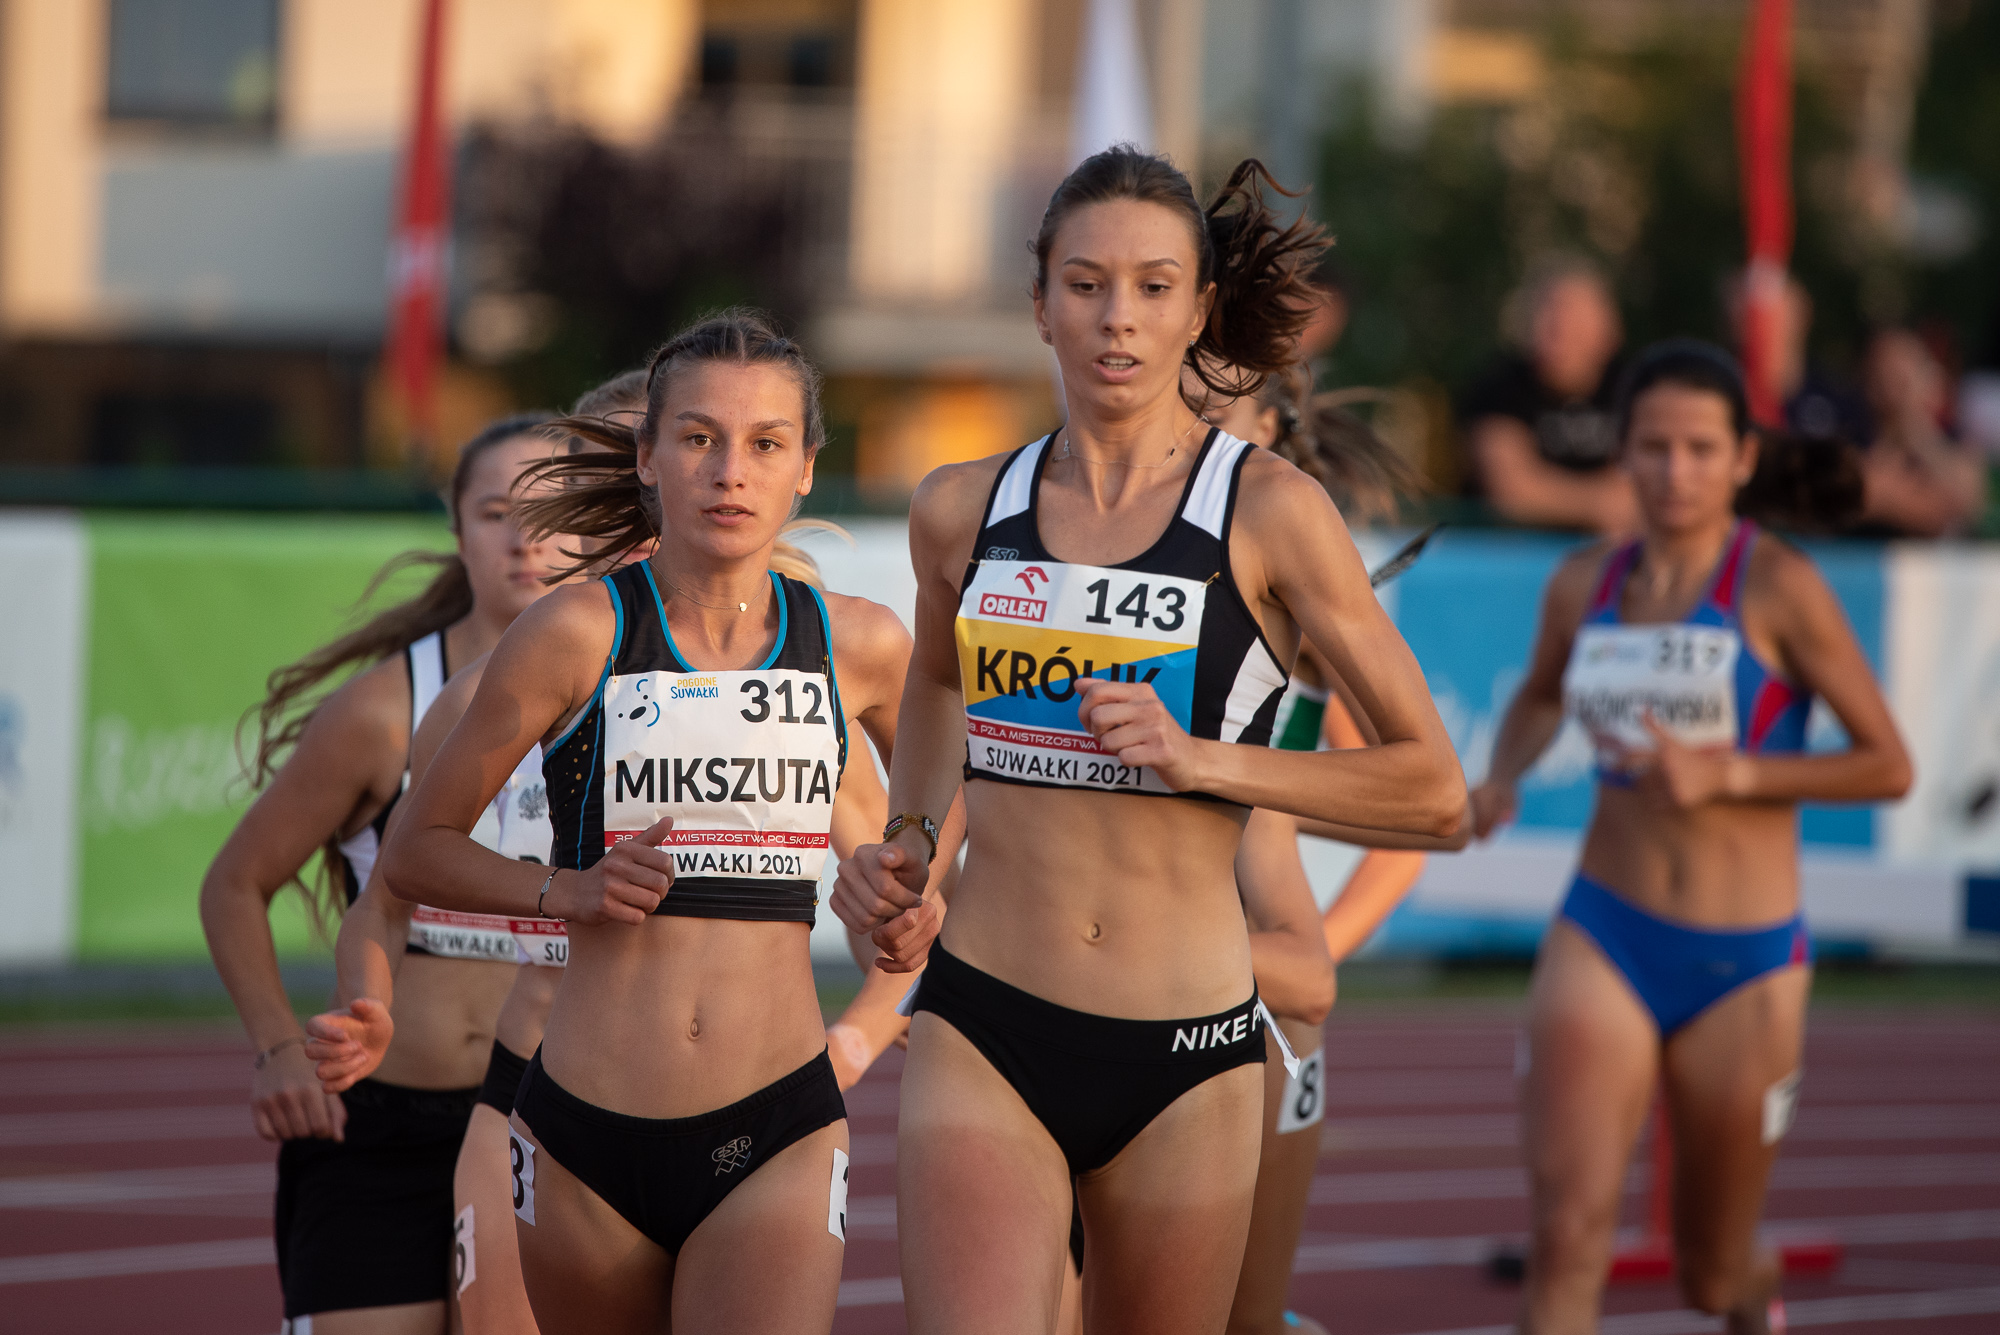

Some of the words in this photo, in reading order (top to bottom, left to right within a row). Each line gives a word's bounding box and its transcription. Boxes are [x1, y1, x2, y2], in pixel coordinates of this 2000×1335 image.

[982, 596, 1043, 619] ORLEN
[1086, 578, 1187, 632] 143
[677, 677, 717, 688] POGODNE
[740, 679, 827, 725] 312
[980, 724, 1007, 739] PZLA
[1008, 731, 1097, 750] MISTRZOSTWA
[615, 757, 831, 804] MIKSZUTA
[985, 746, 1079, 781] SUWAŁKI
[1086, 762, 1143, 787] 2021
[675, 833, 766, 843] MISTRZOSTWA
[767, 834, 806, 845] POLSKI
[806, 836, 826, 845] U23
[669, 853, 752, 874] WAŁKI
[759, 854, 802, 875] 2021
[1171, 1013, 1249, 1052] NIKE
